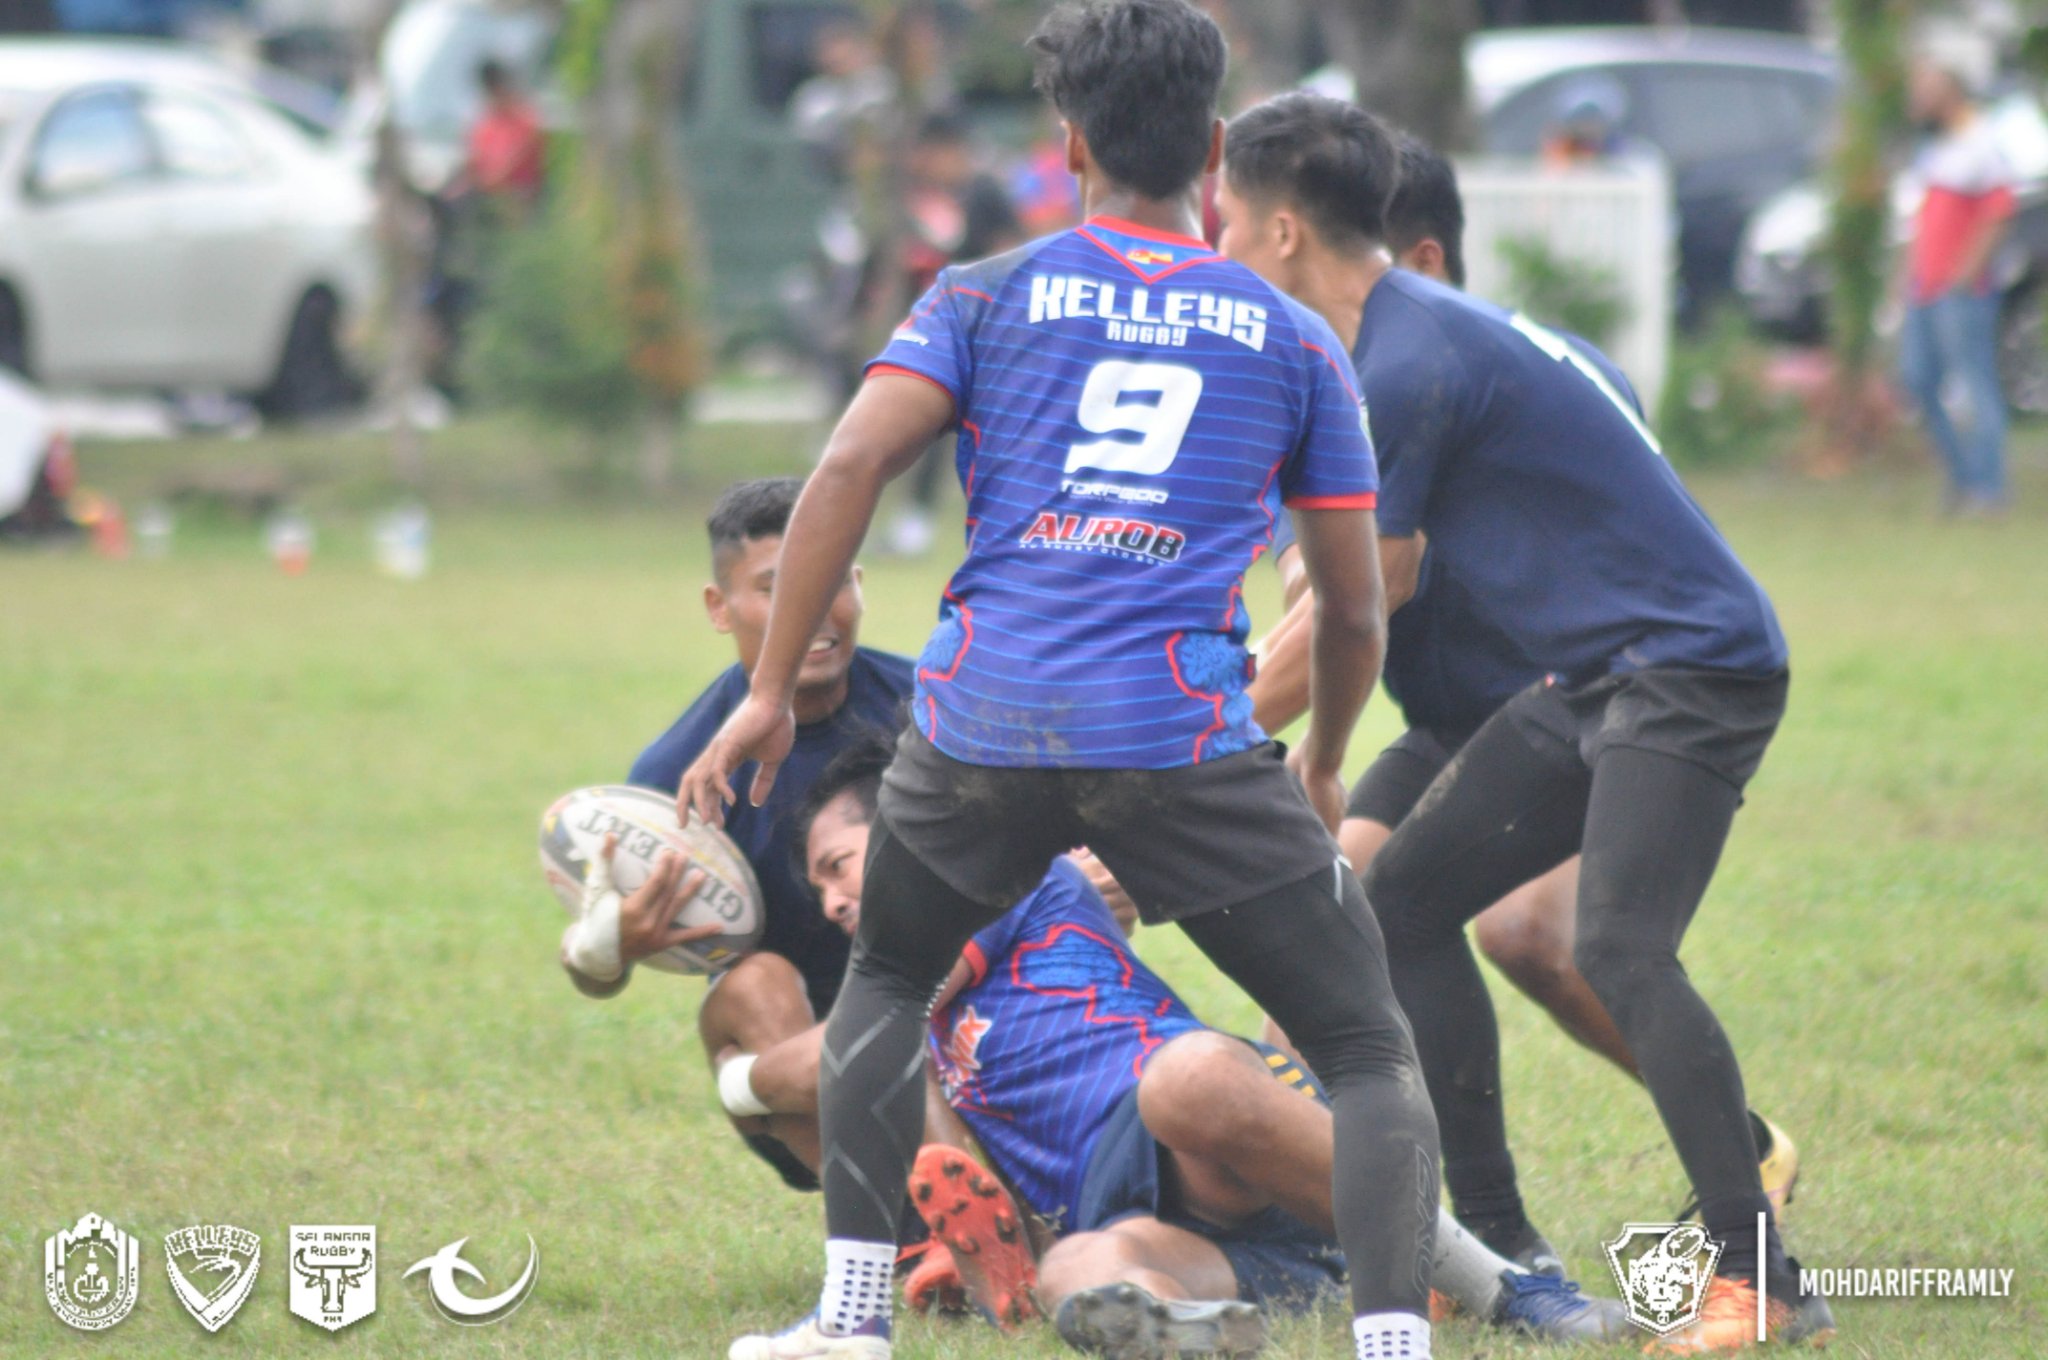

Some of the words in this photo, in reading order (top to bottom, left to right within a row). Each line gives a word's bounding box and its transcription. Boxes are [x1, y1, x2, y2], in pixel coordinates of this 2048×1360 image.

[1029, 276, 1267, 352] KELLEYS
[1106, 320, 1188, 347] RUGBY
[1063, 360, 1204, 476] 9
[578, 809, 746, 923] GIERT
